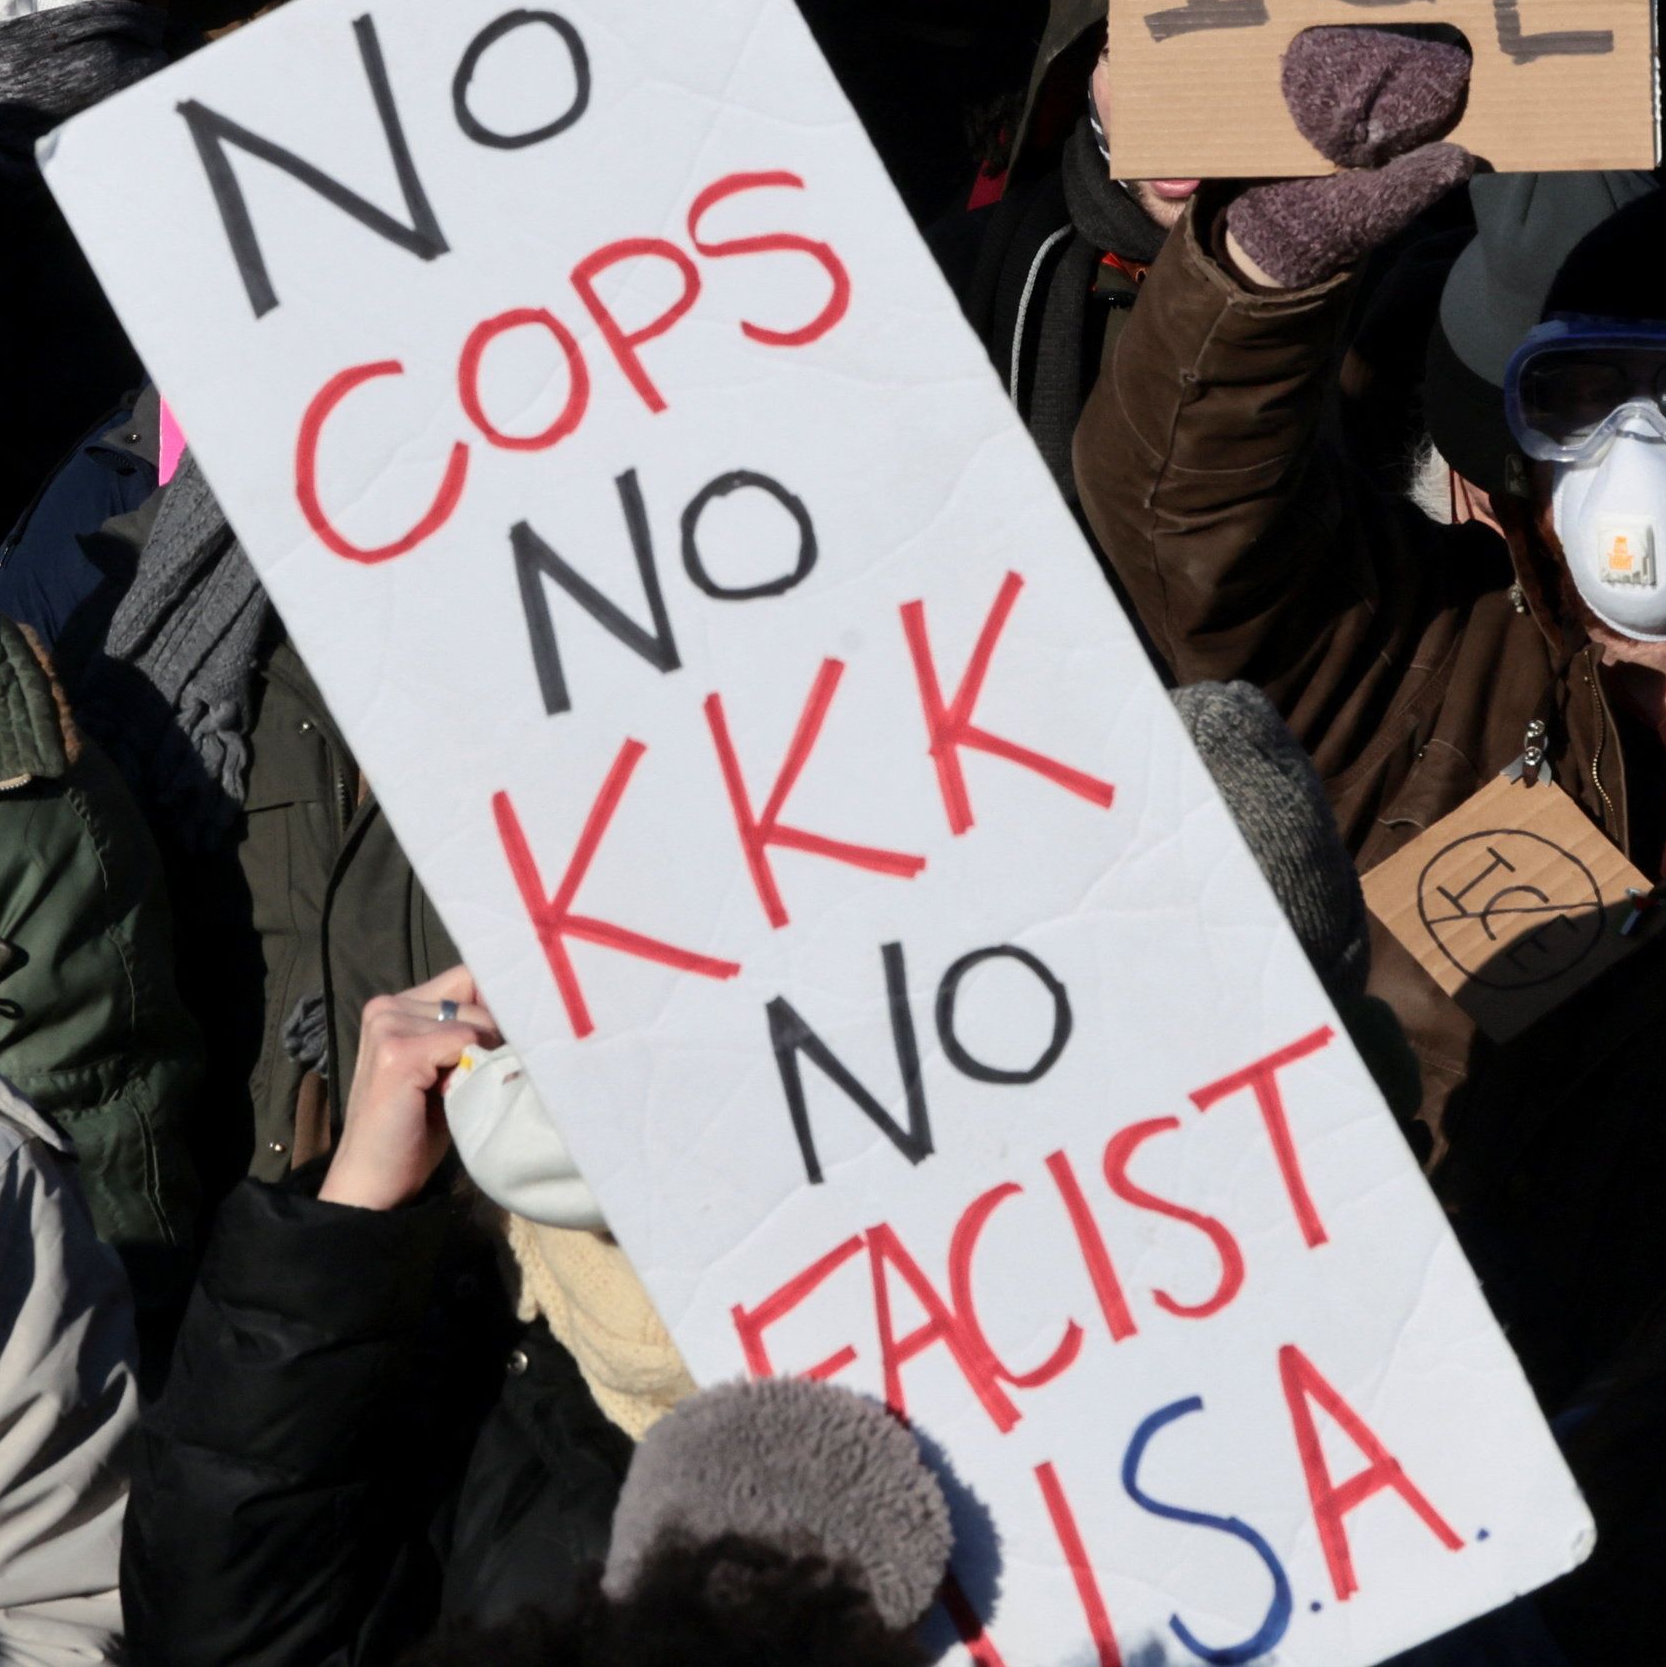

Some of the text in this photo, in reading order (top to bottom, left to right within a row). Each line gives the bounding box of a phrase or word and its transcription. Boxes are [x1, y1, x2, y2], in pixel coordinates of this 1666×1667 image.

[176, 7, 592, 319] NO
[294, 170, 851, 567] COPS
[509, 468, 820, 715] NO
[491, 570, 1115, 1039] KKK
[730, 1024, 1335, 1436] FACIST
[765, 941, 1073, 1185] NO
